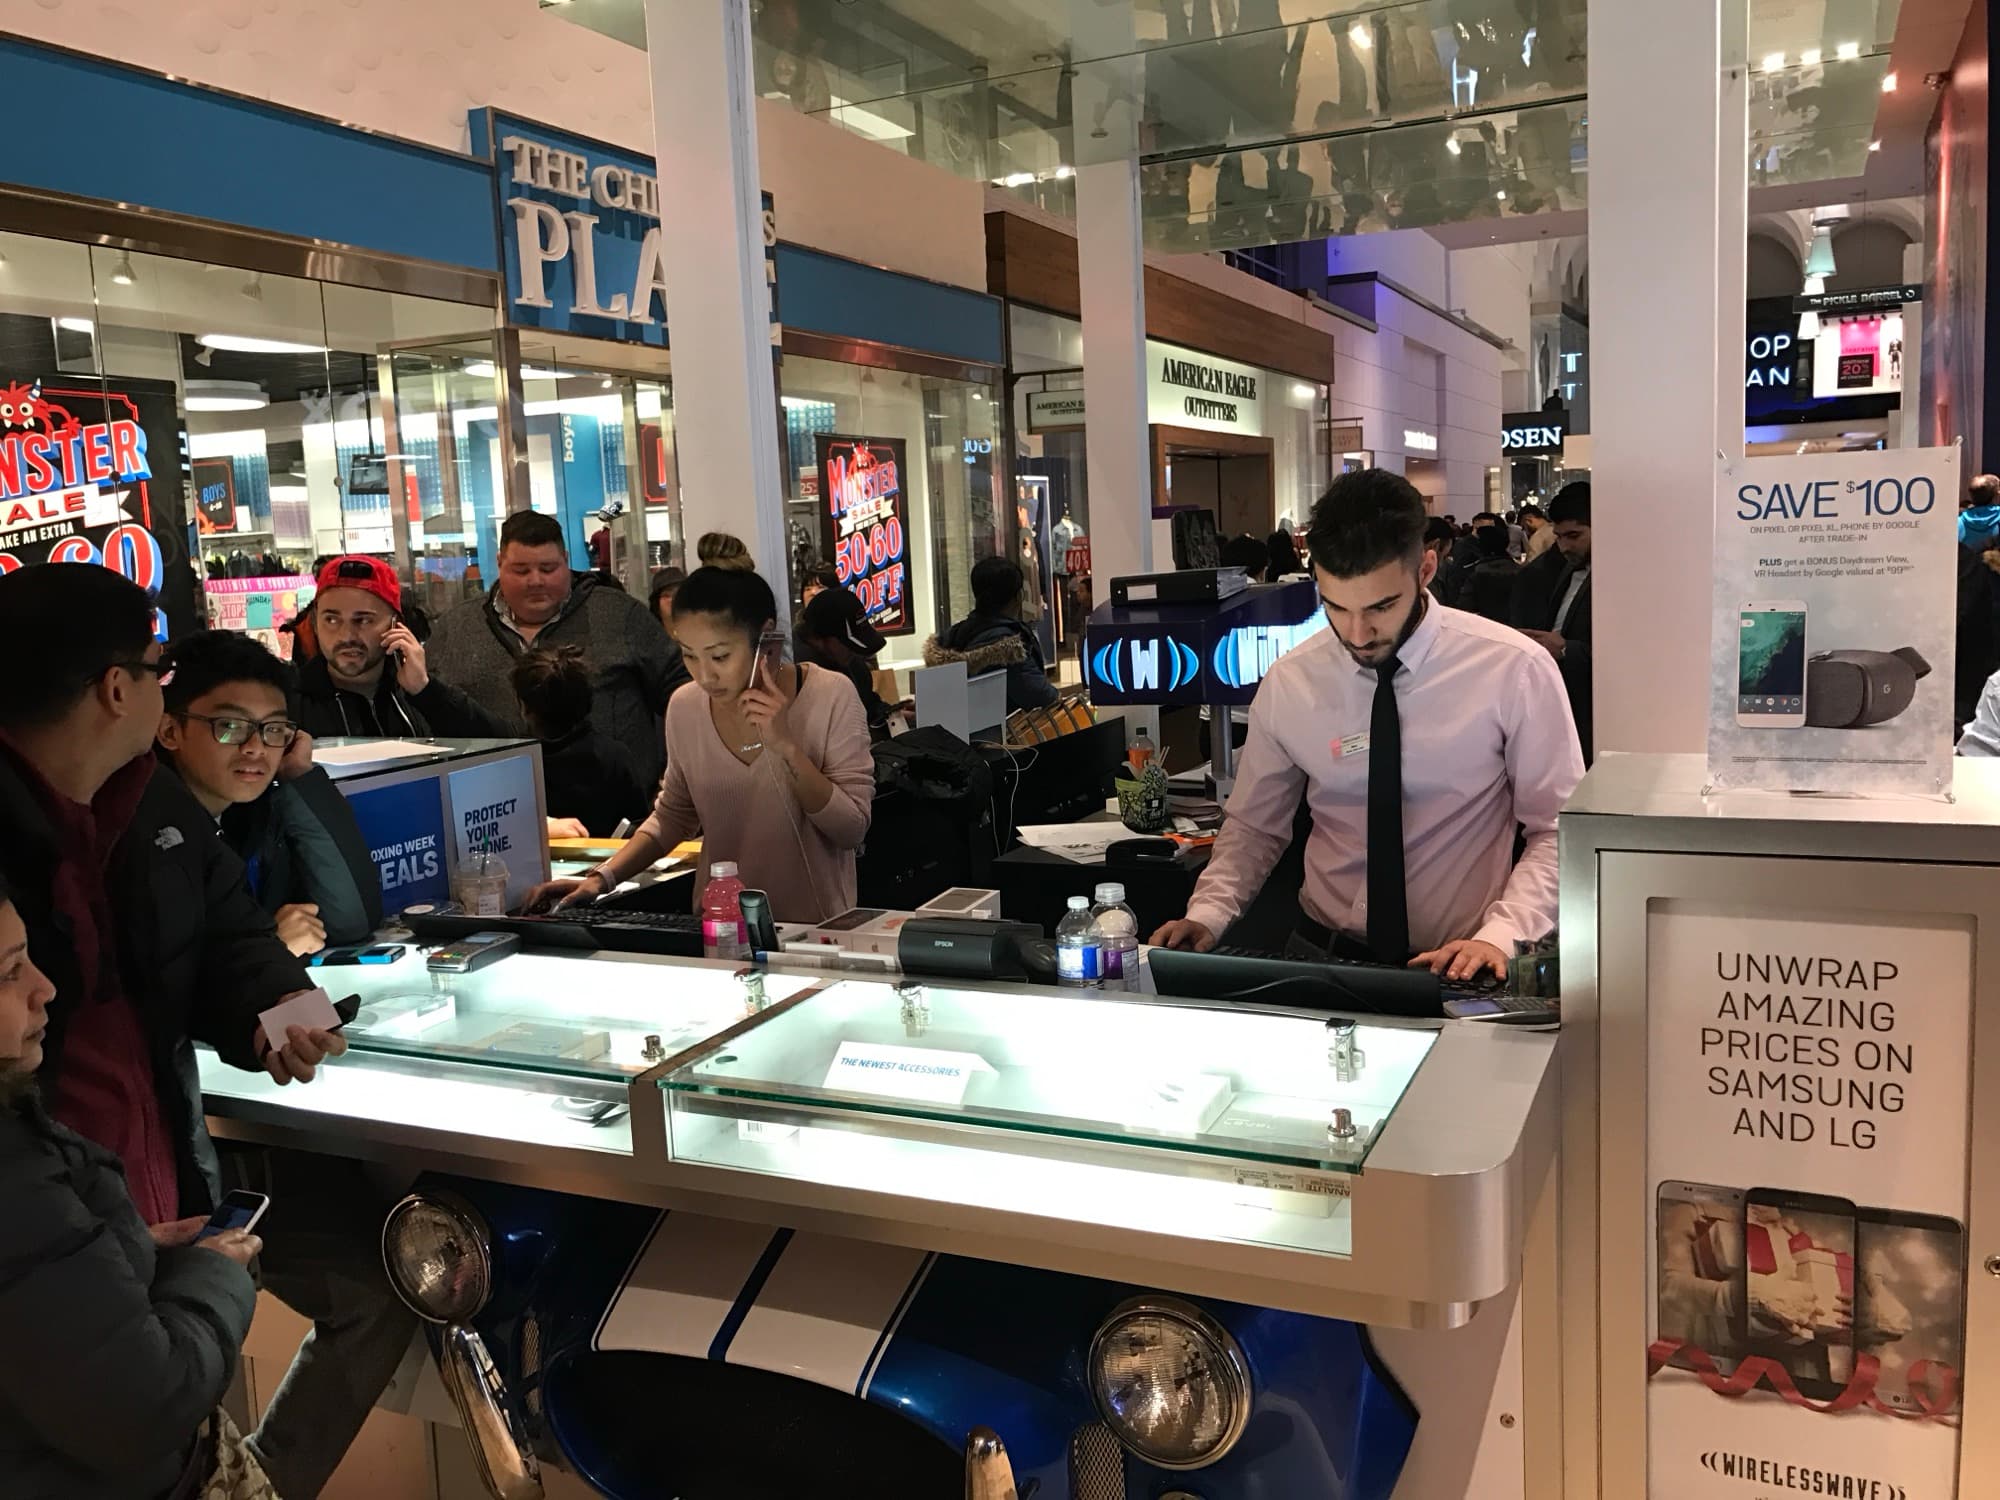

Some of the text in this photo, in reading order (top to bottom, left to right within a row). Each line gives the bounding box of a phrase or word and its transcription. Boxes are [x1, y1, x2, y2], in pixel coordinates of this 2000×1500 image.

[503, 136, 590, 199] THE
[1823, 295, 1857, 306] PICKLE
[1861, 291, 1902, 303] BARREL
[1750, 335, 1791, 359] OP
[1162, 357, 1257, 400] AMERICAN EAGLE
[1746, 367, 1790, 387] AN
[1036, 400, 1077, 410] AMERICAN
[1184, 396, 1238, 423] OUTFITTERS
[563, 415, 575, 463] boys
[202, 482, 226, 505] BOYS
[827, 455, 899, 518] MONSTER
[1737, 476, 1936, 521] SAVE $100
[851, 500, 882, 520] SALE
[23, 529, 38, 545] AN
[40, 521, 75, 541] EXTRA
[1750, 526, 1763, 534] ON
[1764, 526, 1786, 534] PIXEL
[1801, 524, 1824, 532] PIXEL
[1841, 522, 1871, 531] PHONE
[1872, 521, 1883, 529] BY
[1885, 520, 1921, 529] GOOGLE
[1799, 534, 1868, 543] AFTER TRADE-IN
[1754, 569, 1766, 578] VR
[1768, 568, 1801, 577] Headset
[1803, 568, 1813, 579] by
[1815, 567, 1844, 578] Google
[1846, 566, 1874, 576] valued
[1875, 566, 1885, 575] at
[1759, 558, 1782, 567] PLUS
[1784, 559, 1797, 569] get
[1806, 557, 1838, 566] BONUS
[1839, 556, 1885, 567] Daydream
[1130, 638, 1159, 690] W
[464, 798, 517, 828] PROTECT
[466, 821, 499, 844] YOUR
[370, 834, 436, 863] OXING WEEK
[380, 850, 439, 891] EALS
[934, 940, 954, 948] EPSON
[1718, 952, 1899, 991] UNWRAP
[1717, 991, 1895, 1032] AMAZING
[1701, 1028, 1913, 1074] PRICES ON
[841, 1057, 961, 1077] THE NEWEST ACCESSORIES
[1708, 1066, 1905, 1113] SAMSUNG
[1733, 1108, 1877, 1150] AND LG
[1722, 1452, 1881, 1500] WIRELESSWAVE
